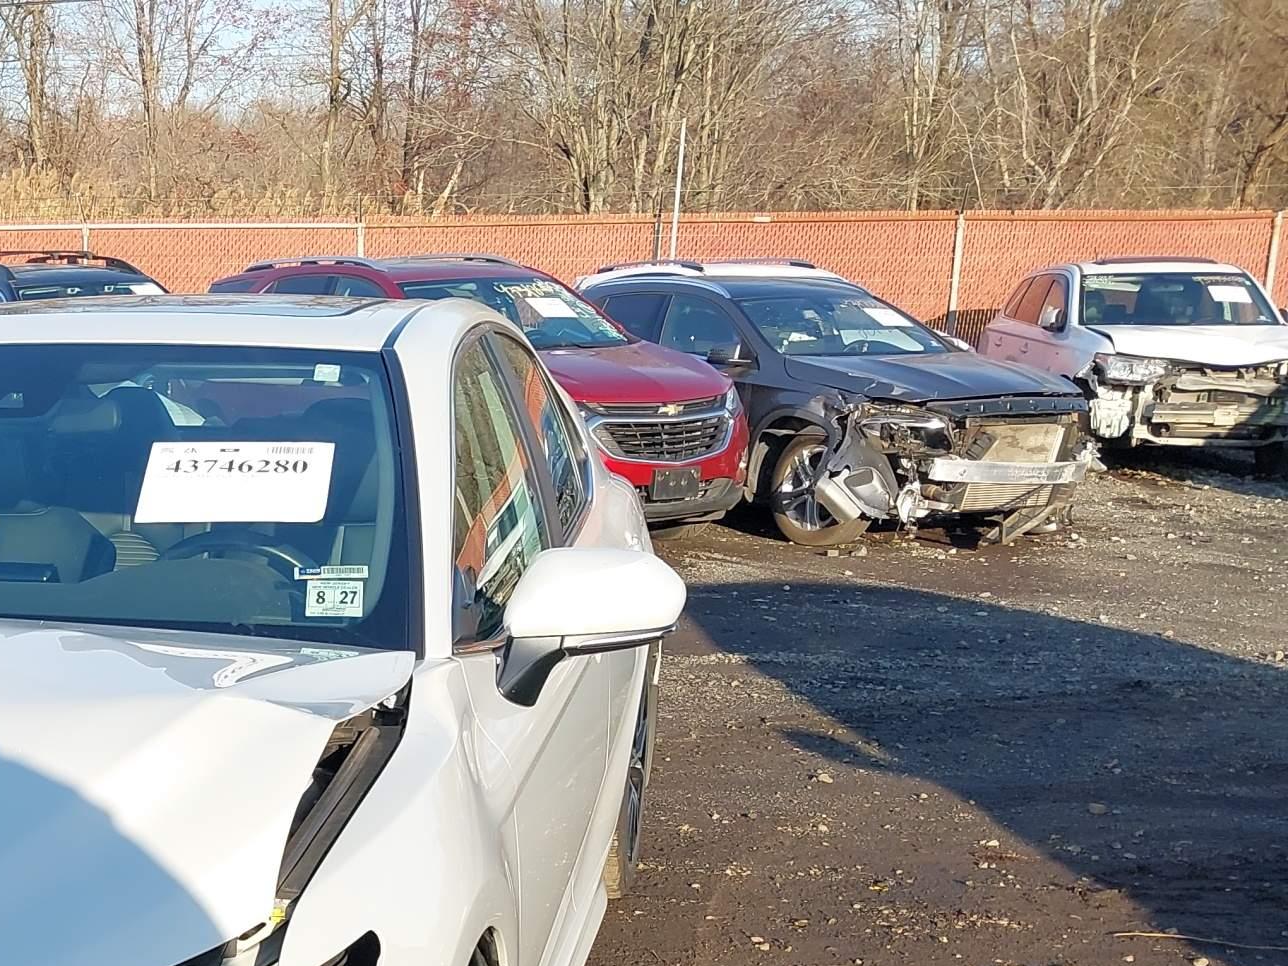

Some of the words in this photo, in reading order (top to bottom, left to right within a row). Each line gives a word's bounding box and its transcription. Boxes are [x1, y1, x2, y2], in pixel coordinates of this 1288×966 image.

[165, 459, 308, 474] 43746280
[315, 590, 326, 605] 8
[338, 590, 358, 605] 27
